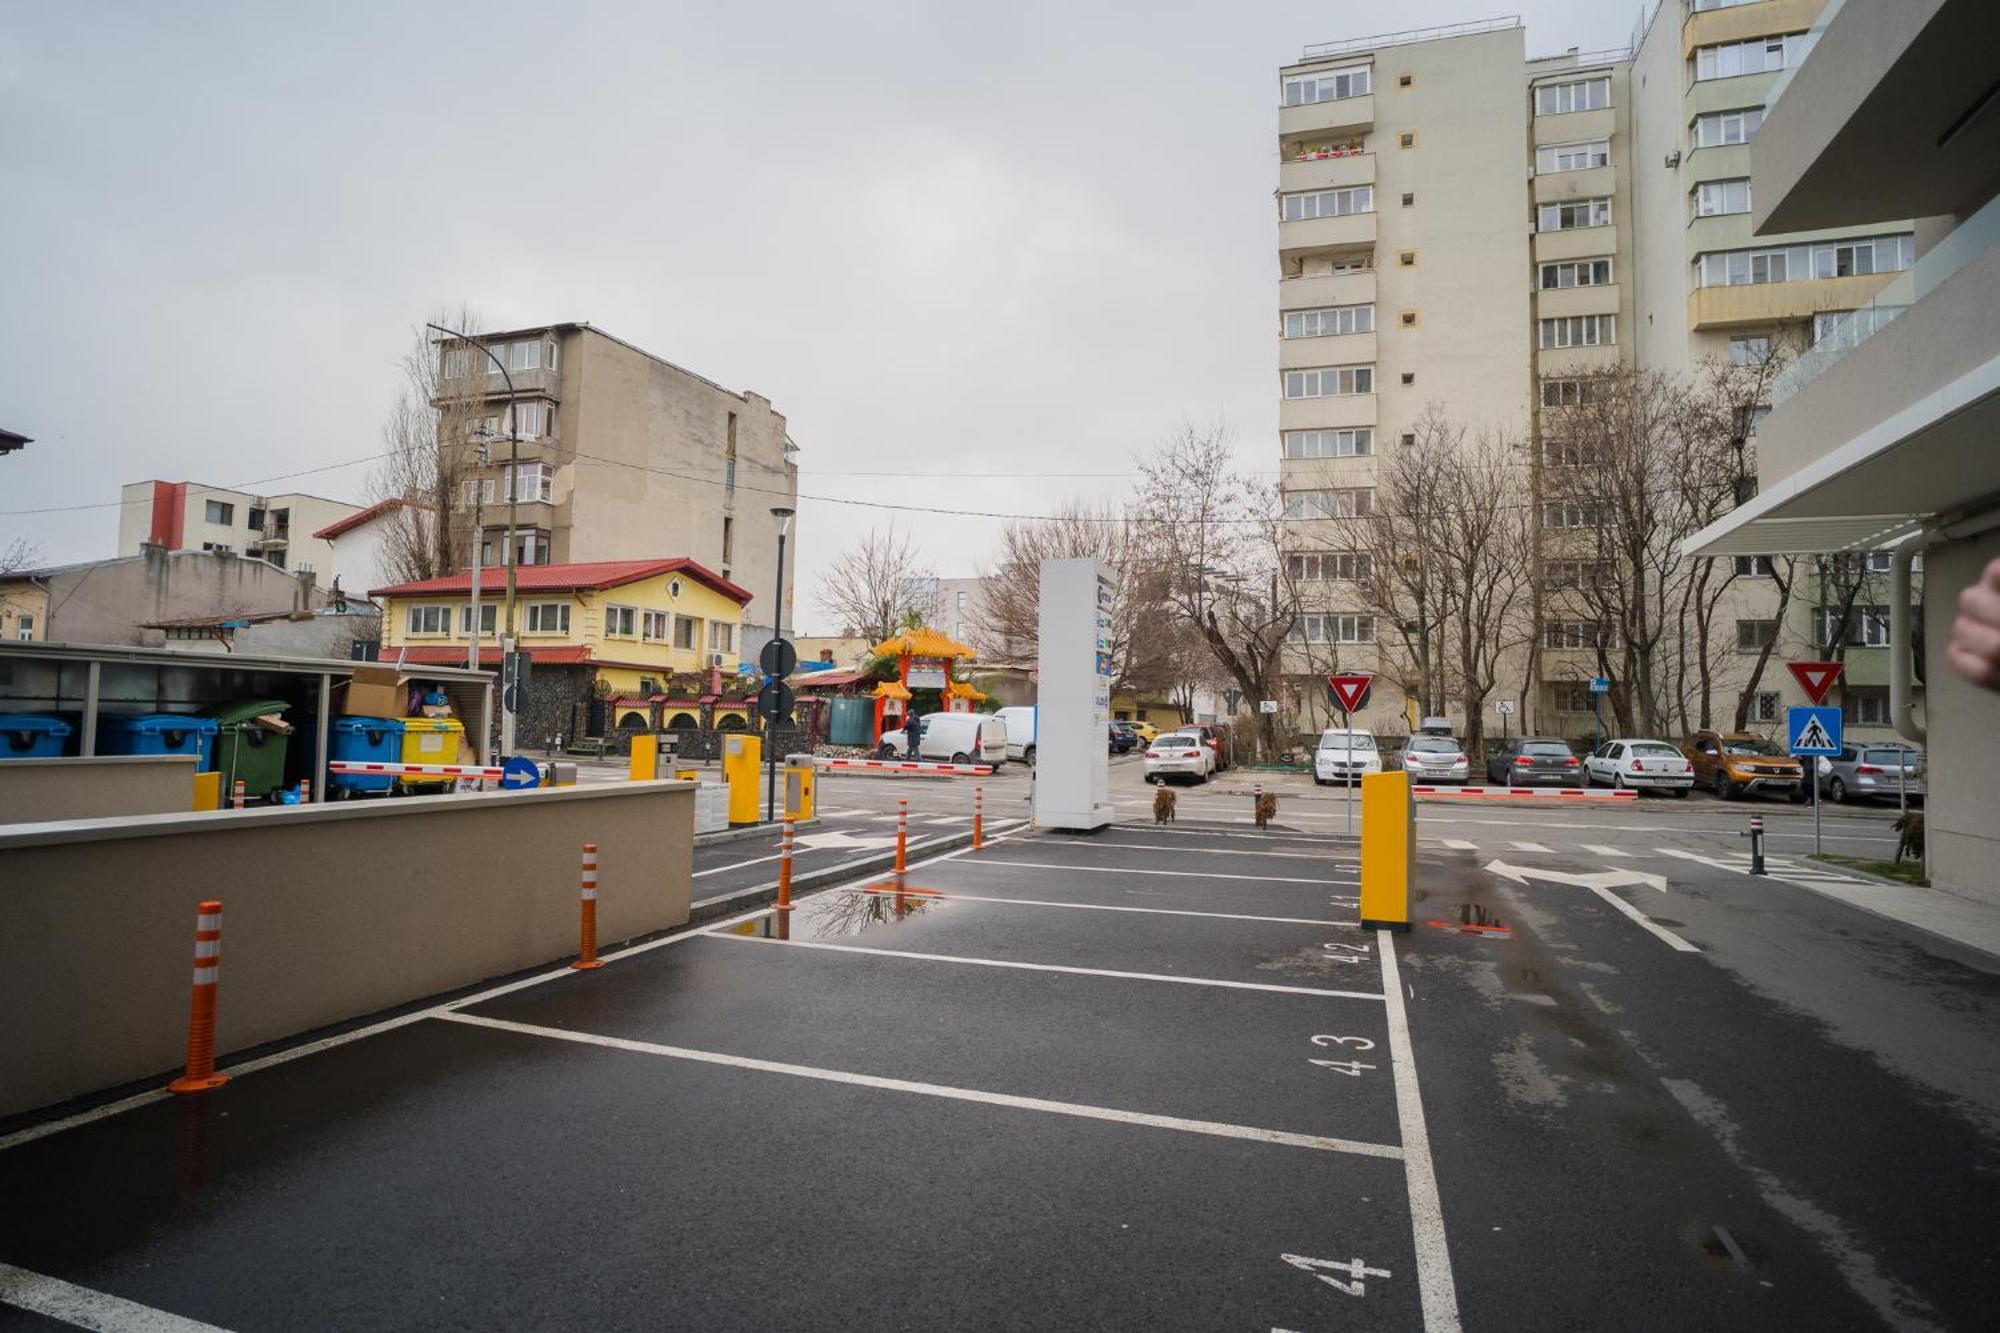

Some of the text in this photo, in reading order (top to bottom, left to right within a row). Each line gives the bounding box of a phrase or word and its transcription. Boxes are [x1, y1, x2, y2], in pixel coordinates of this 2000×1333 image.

[1322, 943, 1370, 964] 42
[1308, 1034, 1377, 1077] 43
[1271, 1252, 1392, 1333] 4
